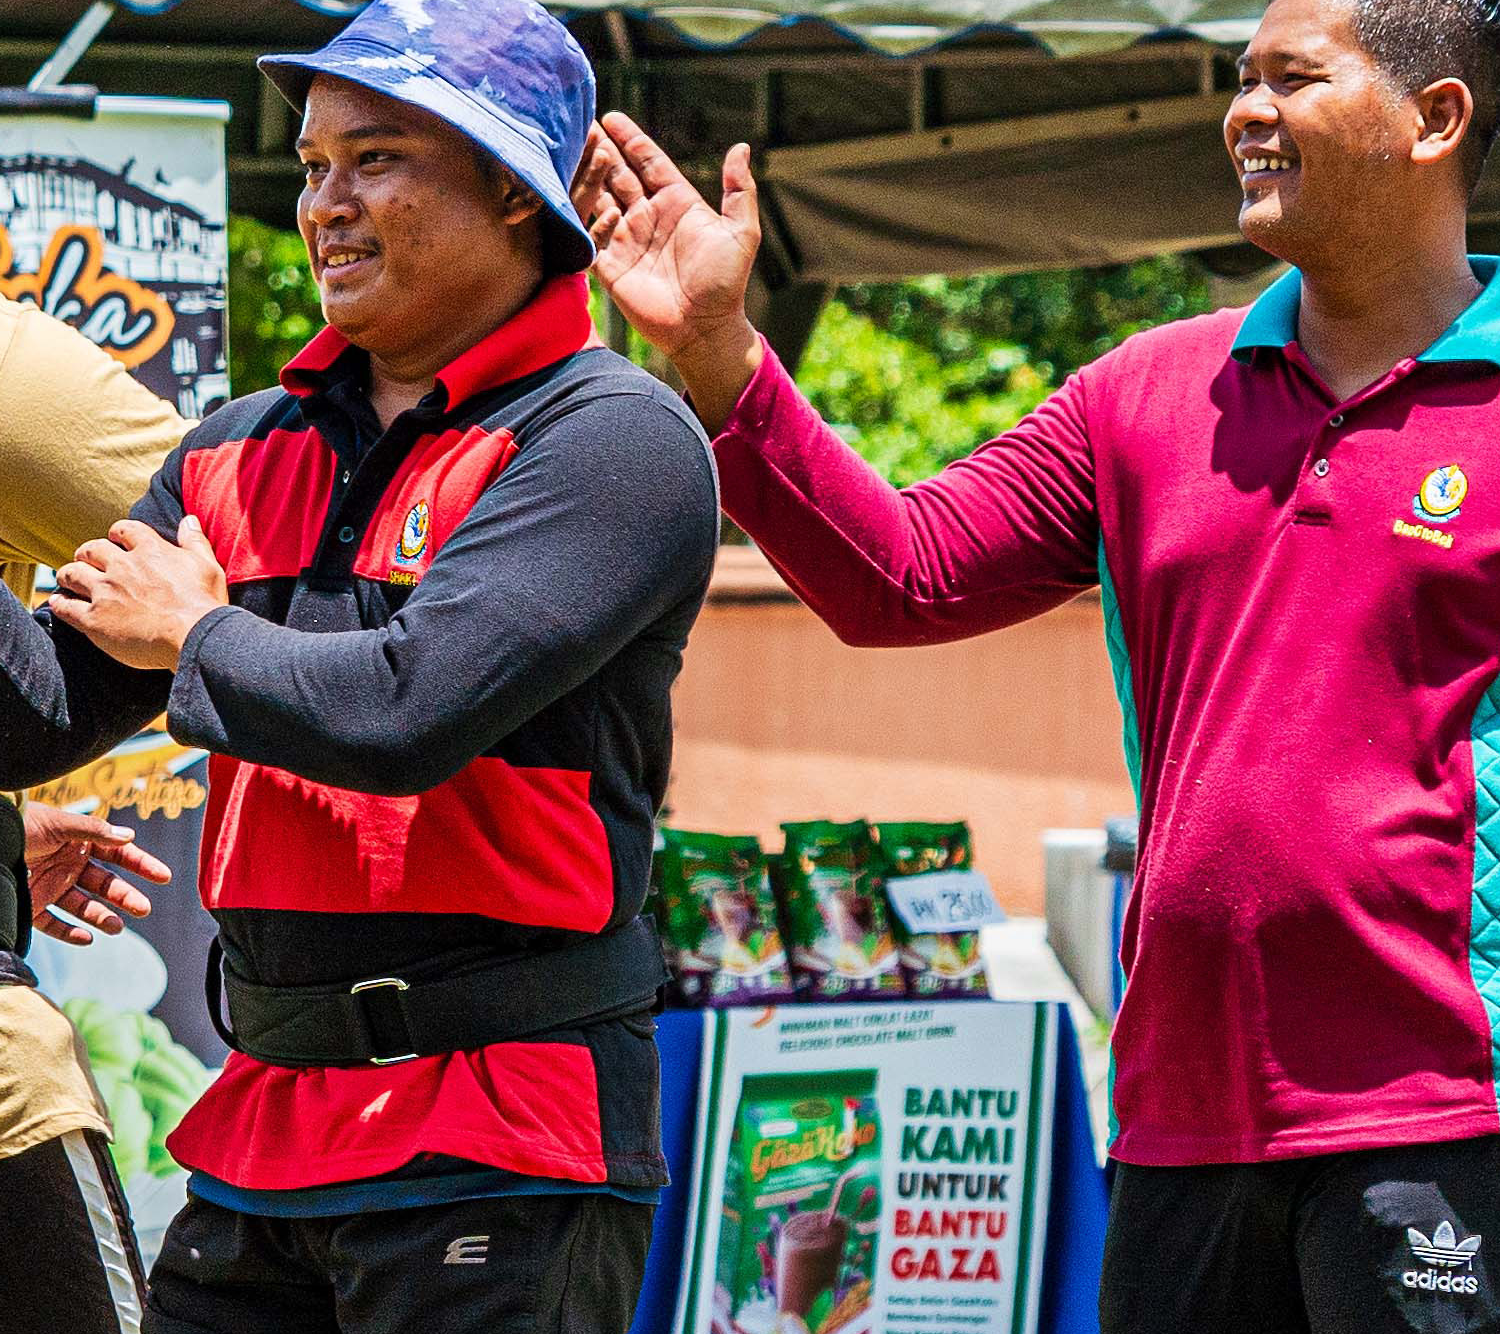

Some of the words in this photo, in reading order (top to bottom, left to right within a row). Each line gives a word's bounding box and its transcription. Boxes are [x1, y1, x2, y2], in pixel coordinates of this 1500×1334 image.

[904, 1087, 1017, 1118] BANTU
[902, 1124, 1015, 1164] KAMI
[897, 1172, 1009, 1201] UNTUK
[894, 1208, 1008, 1240] BANTU
[890, 1246, 1002, 1283] GAZA
[1403, 1268, 1479, 1295] adidas
